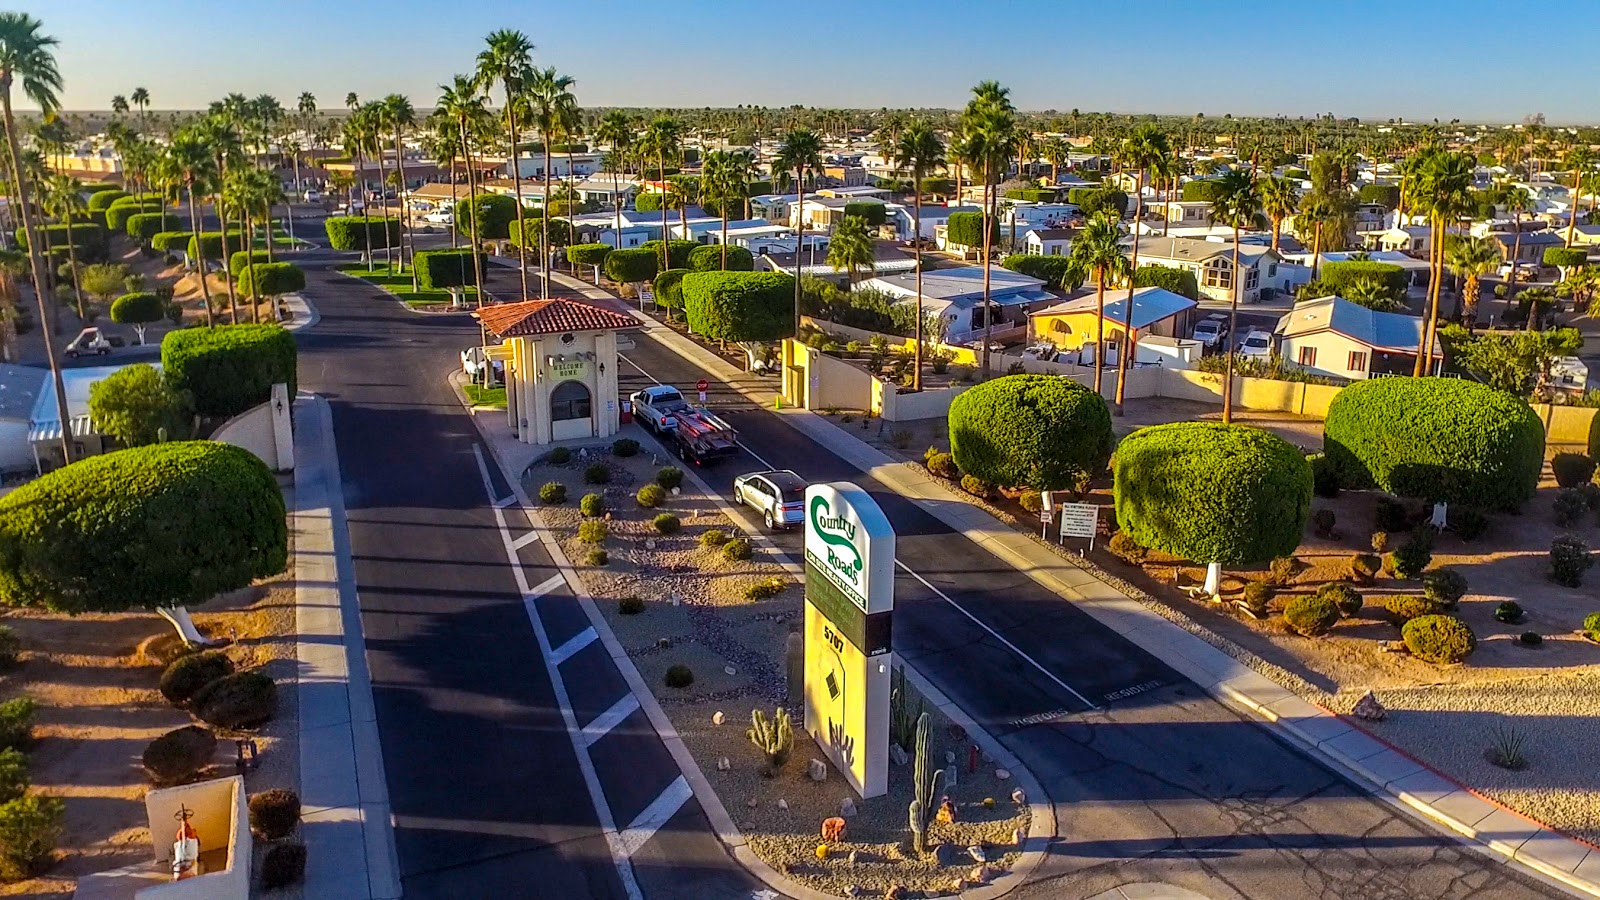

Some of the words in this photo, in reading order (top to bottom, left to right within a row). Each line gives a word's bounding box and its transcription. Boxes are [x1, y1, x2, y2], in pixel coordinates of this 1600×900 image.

[811, 496, 857, 546] Country
[827, 546, 858, 586] Roads
[828, 568, 847, 592] REALTY
[847, 585, 865, 607] OFFICE
[824, 625, 844, 654] 5707
[1104, 680, 1160, 701] RESIDENT
[1008, 708, 1069, 728] VISITORS
